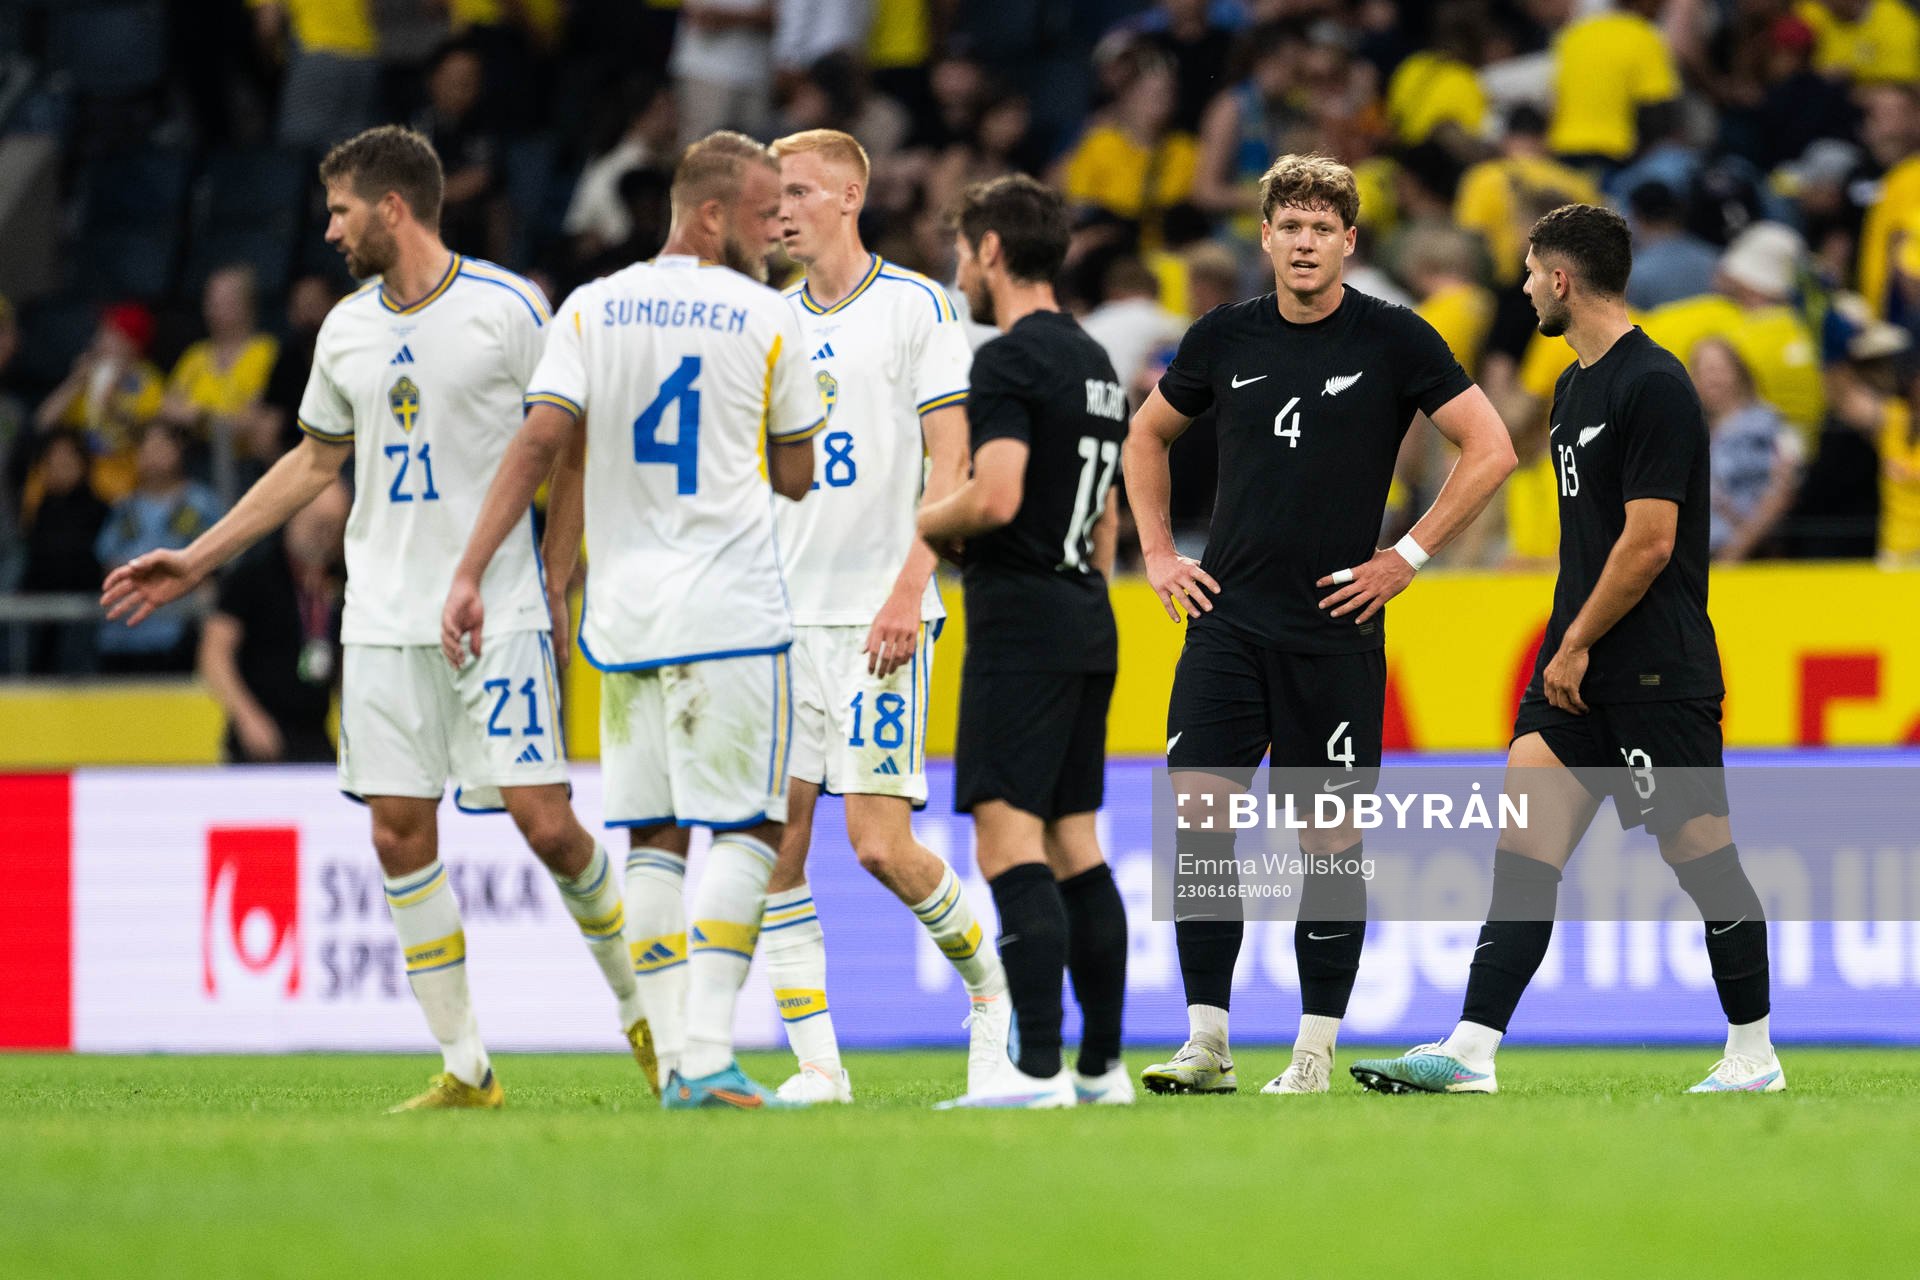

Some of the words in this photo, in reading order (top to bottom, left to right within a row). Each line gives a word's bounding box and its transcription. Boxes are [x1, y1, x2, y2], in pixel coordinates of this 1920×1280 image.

[603, 298, 748, 335] SUNDGREN
[633, 355, 702, 495] 4
[1274, 396, 1301, 448] 4
[384, 442, 440, 503] 21
[811, 431, 857, 488] 8
[1558, 444, 1580, 497] 13
[484, 677, 544, 737] 21
[848, 691, 906, 750] 18
[1327, 721, 1356, 772] 4
